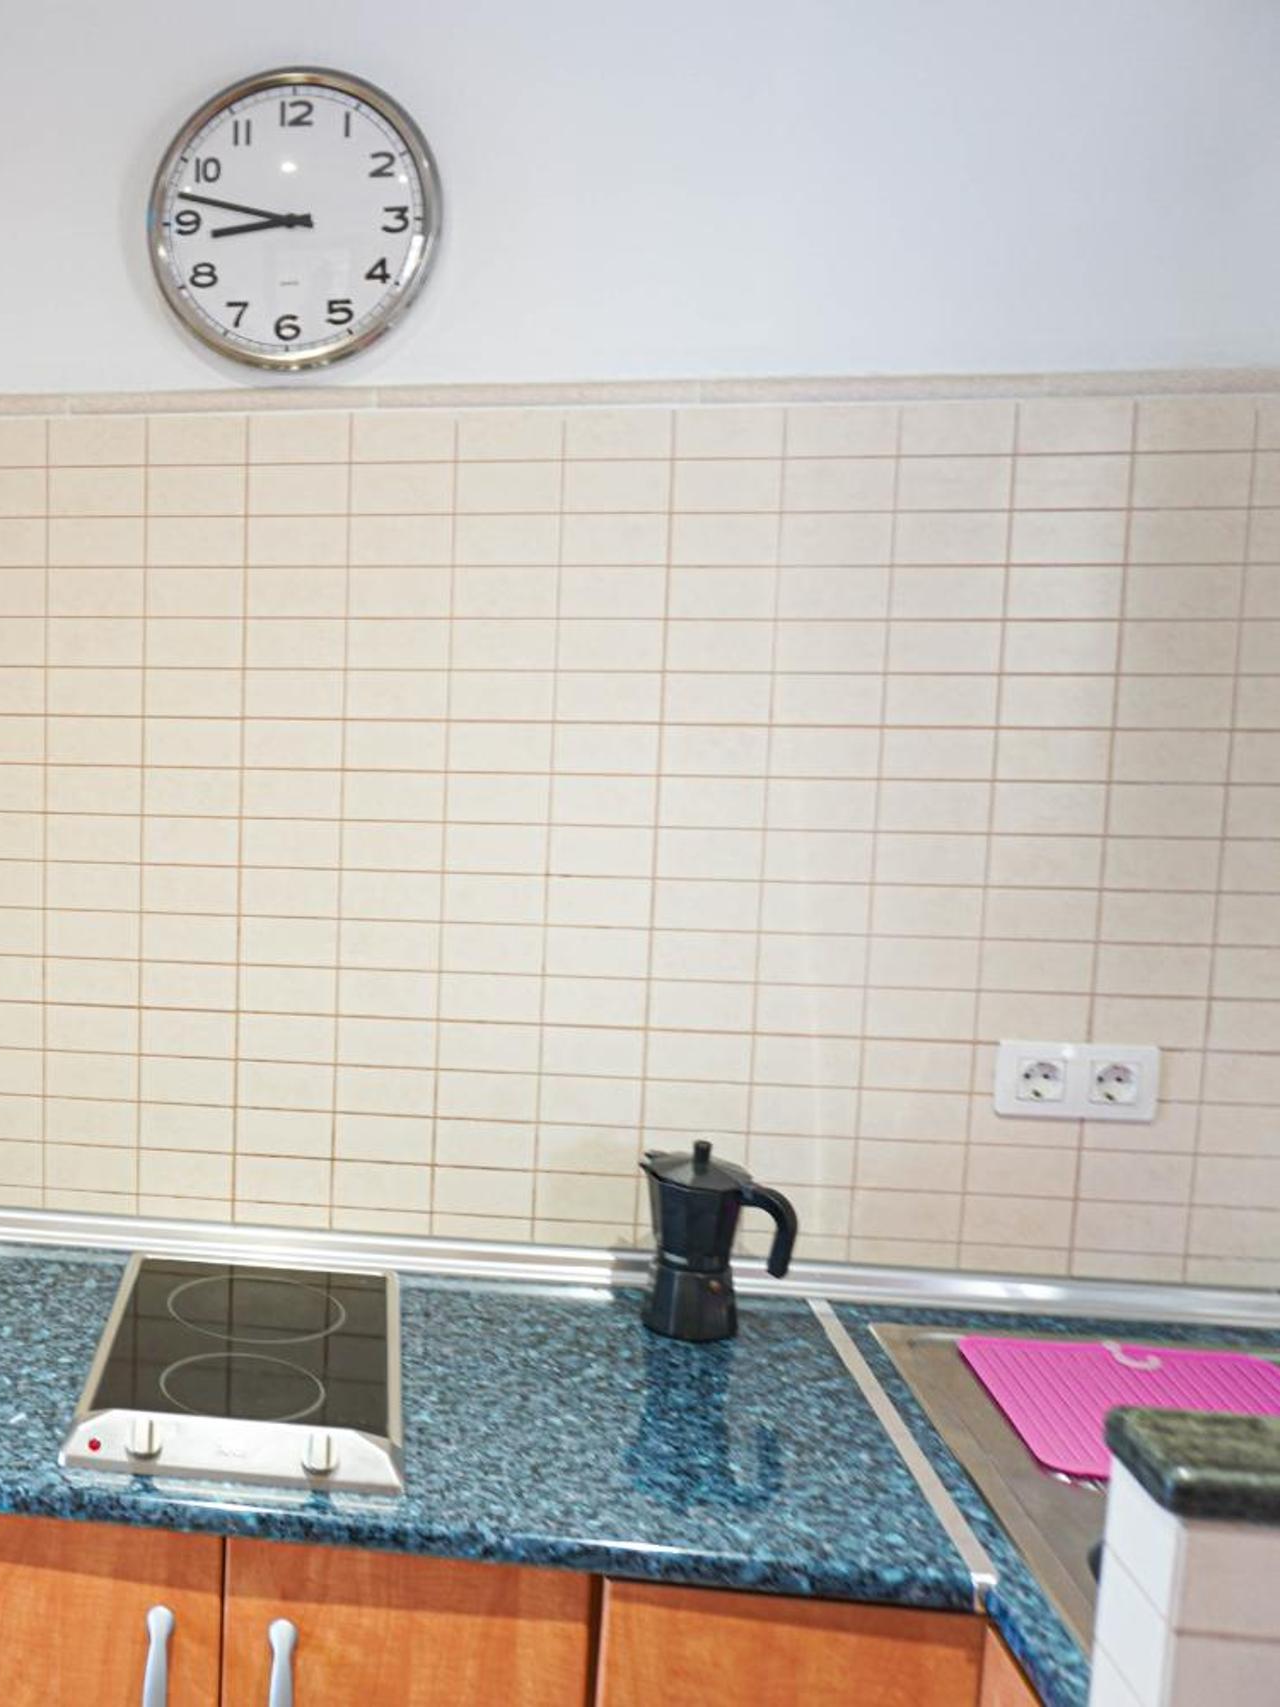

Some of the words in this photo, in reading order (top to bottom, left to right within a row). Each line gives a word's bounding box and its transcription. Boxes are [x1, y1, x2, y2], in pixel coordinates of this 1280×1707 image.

[280, 100, 314, 127] 12
[344, 111, 351, 138] 1
[233, 119, 251, 146] 11
[194, 157, 221, 183] 10
[368, 151, 396, 178] 2
[175, 209, 202, 236] 9
[382, 205, 410, 234] 3
[189, 262, 219, 289] 8
[364, 257, 391, 284] 4
[225, 301, 249, 328] 7
[326, 299, 354, 326] 5
[274, 314, 301, 342] 6
